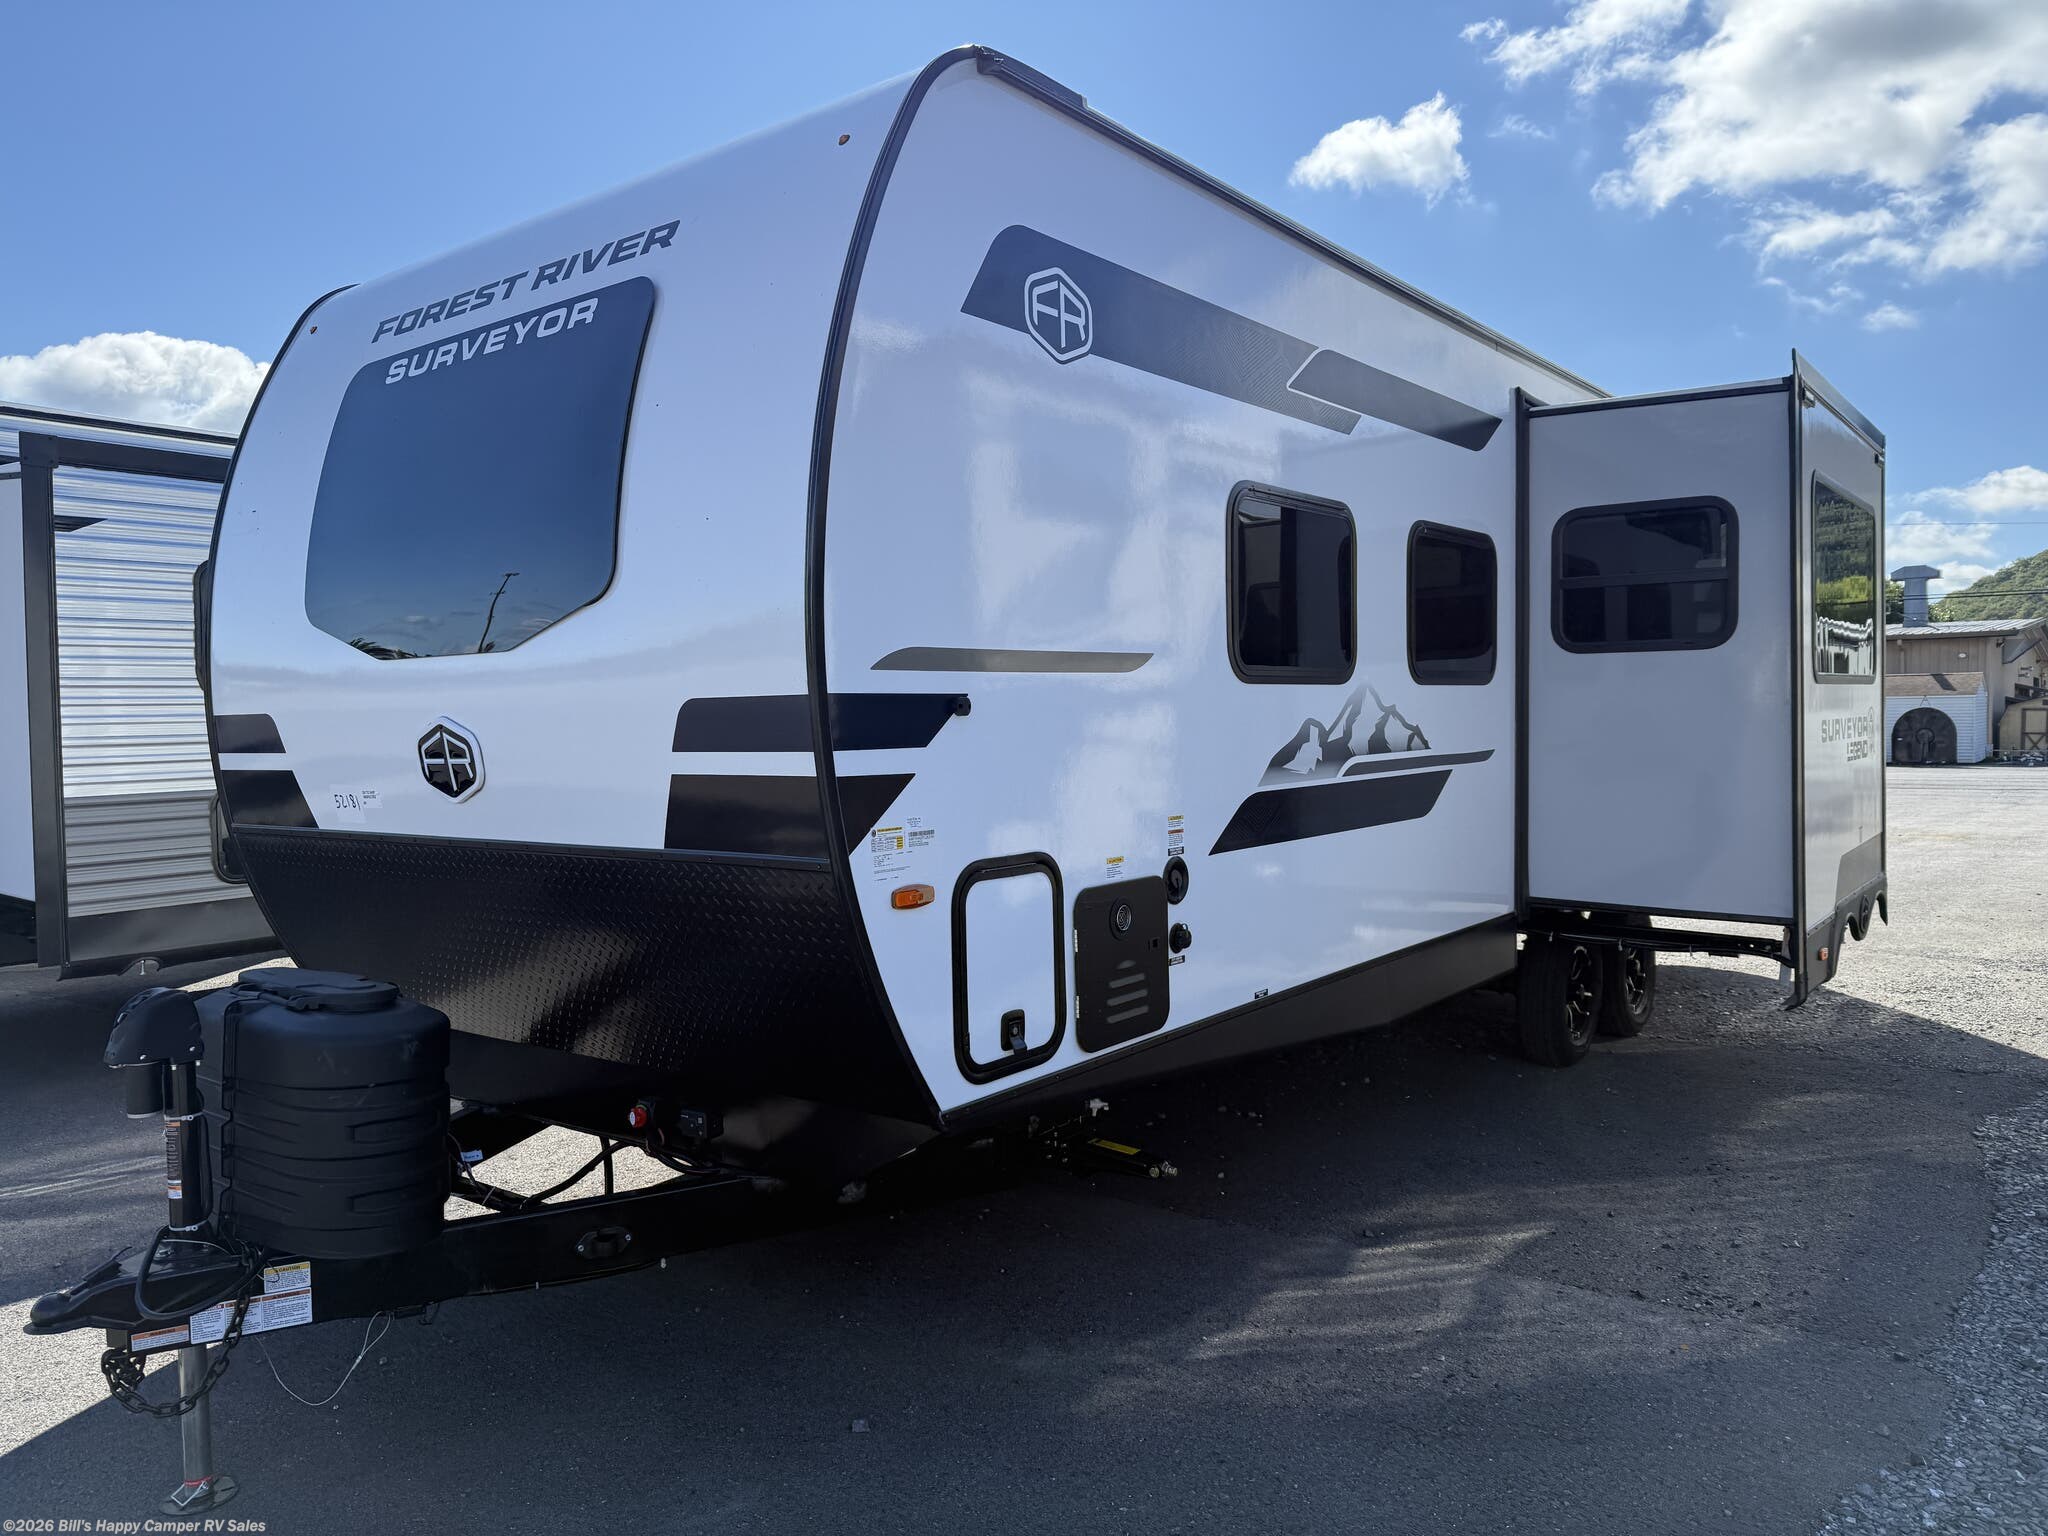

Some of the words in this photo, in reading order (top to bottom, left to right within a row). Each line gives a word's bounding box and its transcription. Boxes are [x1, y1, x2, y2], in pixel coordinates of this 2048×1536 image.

[371, 270, 530, 344] FOREST
[530, 220, 681, 291] RIVER
[1032, 280, 1086, 348] FR
[384, 297, 599, 385] SURVEYOR
[421, 731, 474, 792] FR
[1821, 715, 1869, 743] SURVEYOR
